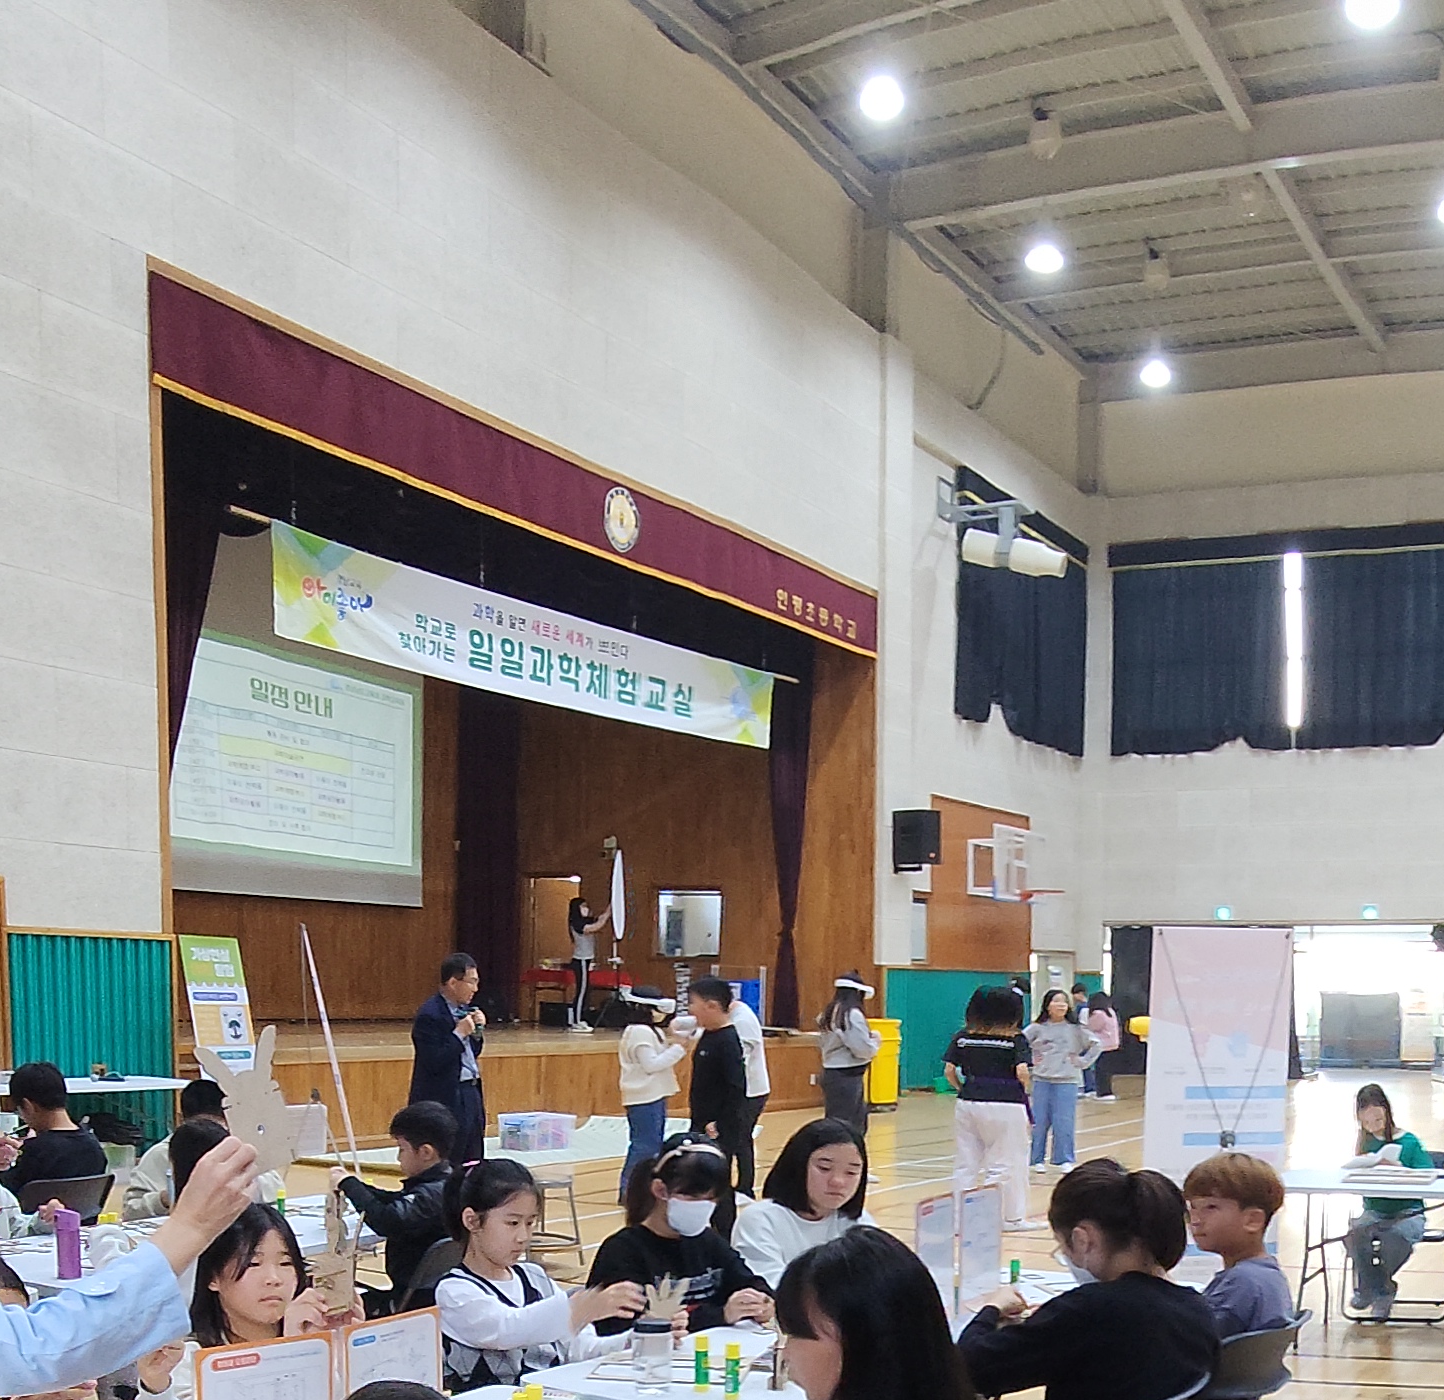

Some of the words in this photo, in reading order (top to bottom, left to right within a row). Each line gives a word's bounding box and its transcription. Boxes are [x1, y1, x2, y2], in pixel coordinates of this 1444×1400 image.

[415, 612, 457, 642] 학교로
[472, 602, 505, 627] 과학을
[531, 618, 562, 642] 새로운
[565, 628, 594, 651] 세계가
[776, 589, 857, 640] 인평초등학교
[397, 630, 457, 664] 찾아가는
[468, 628, 694, 719] 일일과학체험교실
[293, 690, 334, 719] 안내
